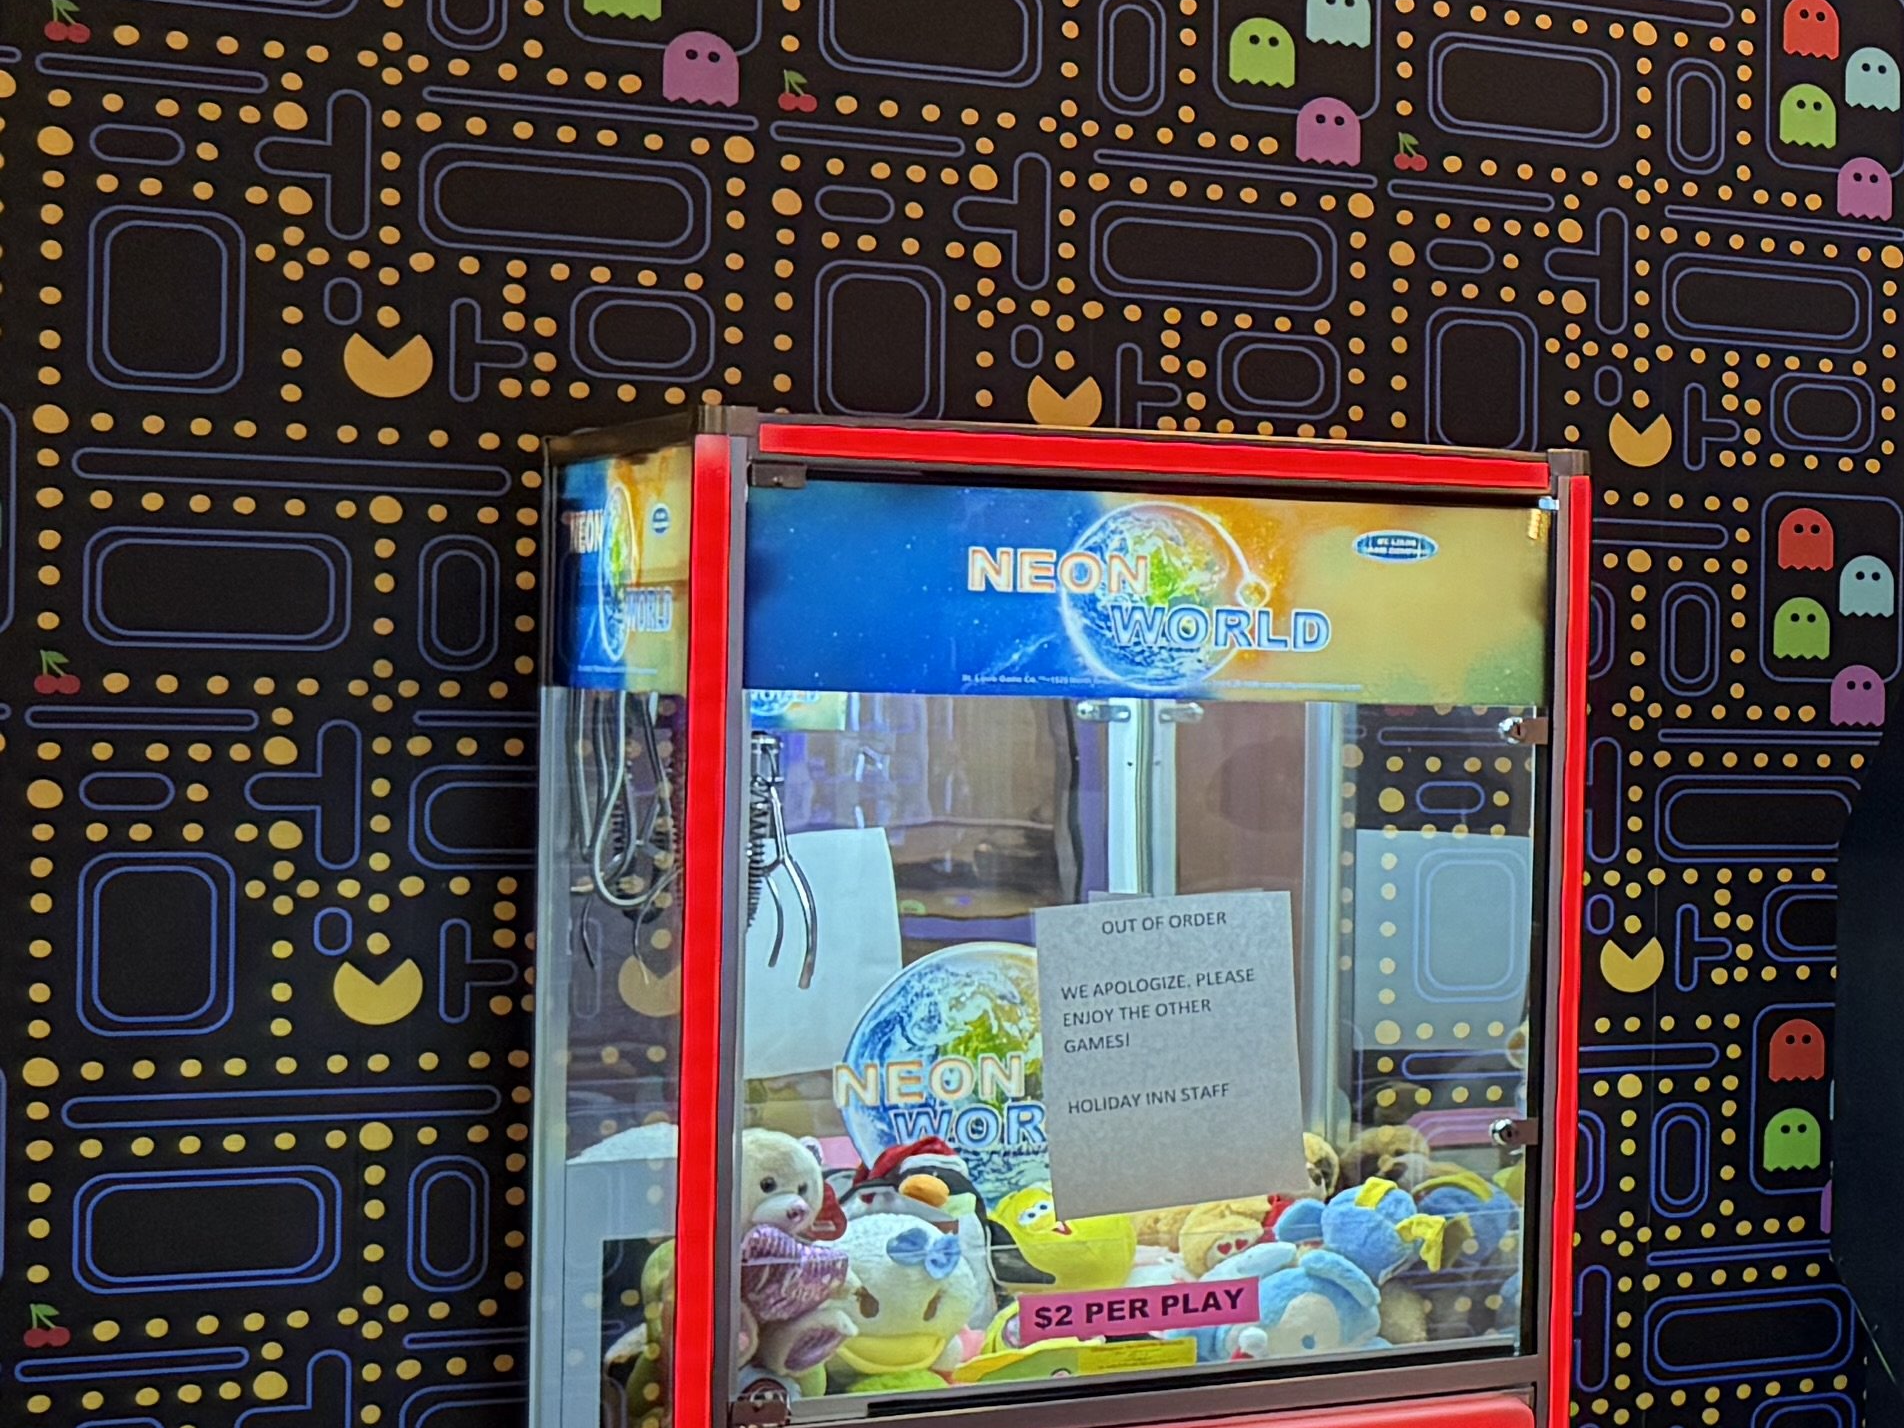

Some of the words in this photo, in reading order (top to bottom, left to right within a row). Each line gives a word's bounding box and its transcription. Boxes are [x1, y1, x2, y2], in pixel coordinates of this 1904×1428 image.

[967, 546, 1150, 595] NEON
[1111, 604, 1332, 651] WORLD
[1102, 919, 1137, 935] OUT
[1142, 916, 1163, 932] OF
[1169, 911, 1227, 929] ORDER
[1061, 984, 1088, 1000] WE
[1093, 974, 1191, 997] APOLOGIZE.
[1196, 968, 1256, 987] PLEASE
[1063, 1009, 1114, 1027] ENJOY
[1119, 1005, 1151, 1021] THE
[1155, 999, 1212, 1018] OTHER
[1064, 1033, 1130, 1053] GAMES!
[833, 1052, 1025, 1108] NEON
[1068, 1093, 1141, 1114] HOLIDAY
[1146, 1089, 1176, 1106] INN
[1181, 1083, 1230, 1102] STAFF
[890, 1101, 1048, 1151] WOR
[1034, 1304, 1073, 1330] $2
[1085, 1298, 1149, 1323] PER
[1161, 1287, 1245, 1317] PLAY
